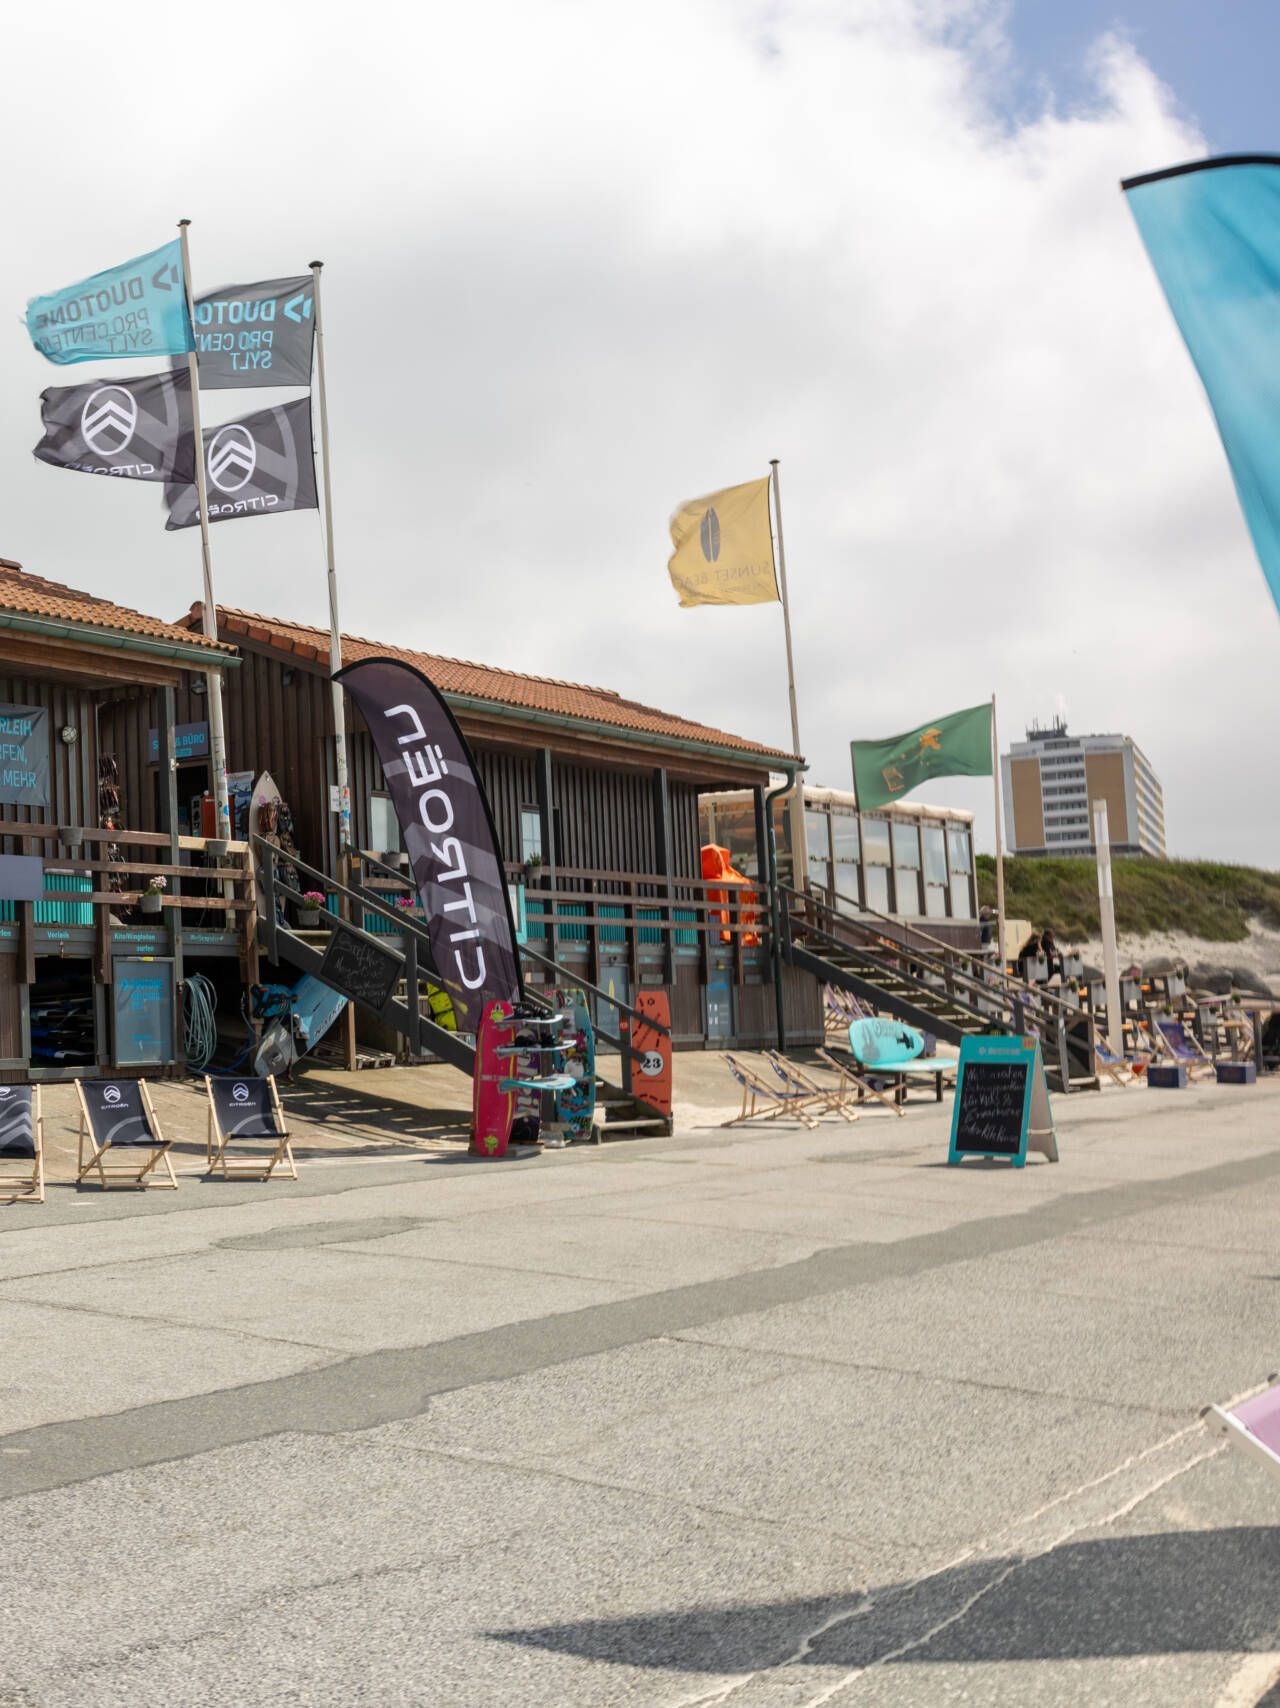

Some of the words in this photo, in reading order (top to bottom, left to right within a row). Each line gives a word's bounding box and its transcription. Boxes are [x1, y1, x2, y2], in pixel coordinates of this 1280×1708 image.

[3, 769, 37, 788] MEHR
[384, 704, 487, 990] CITROËN
[643, 1058, 661, 1068] 23
